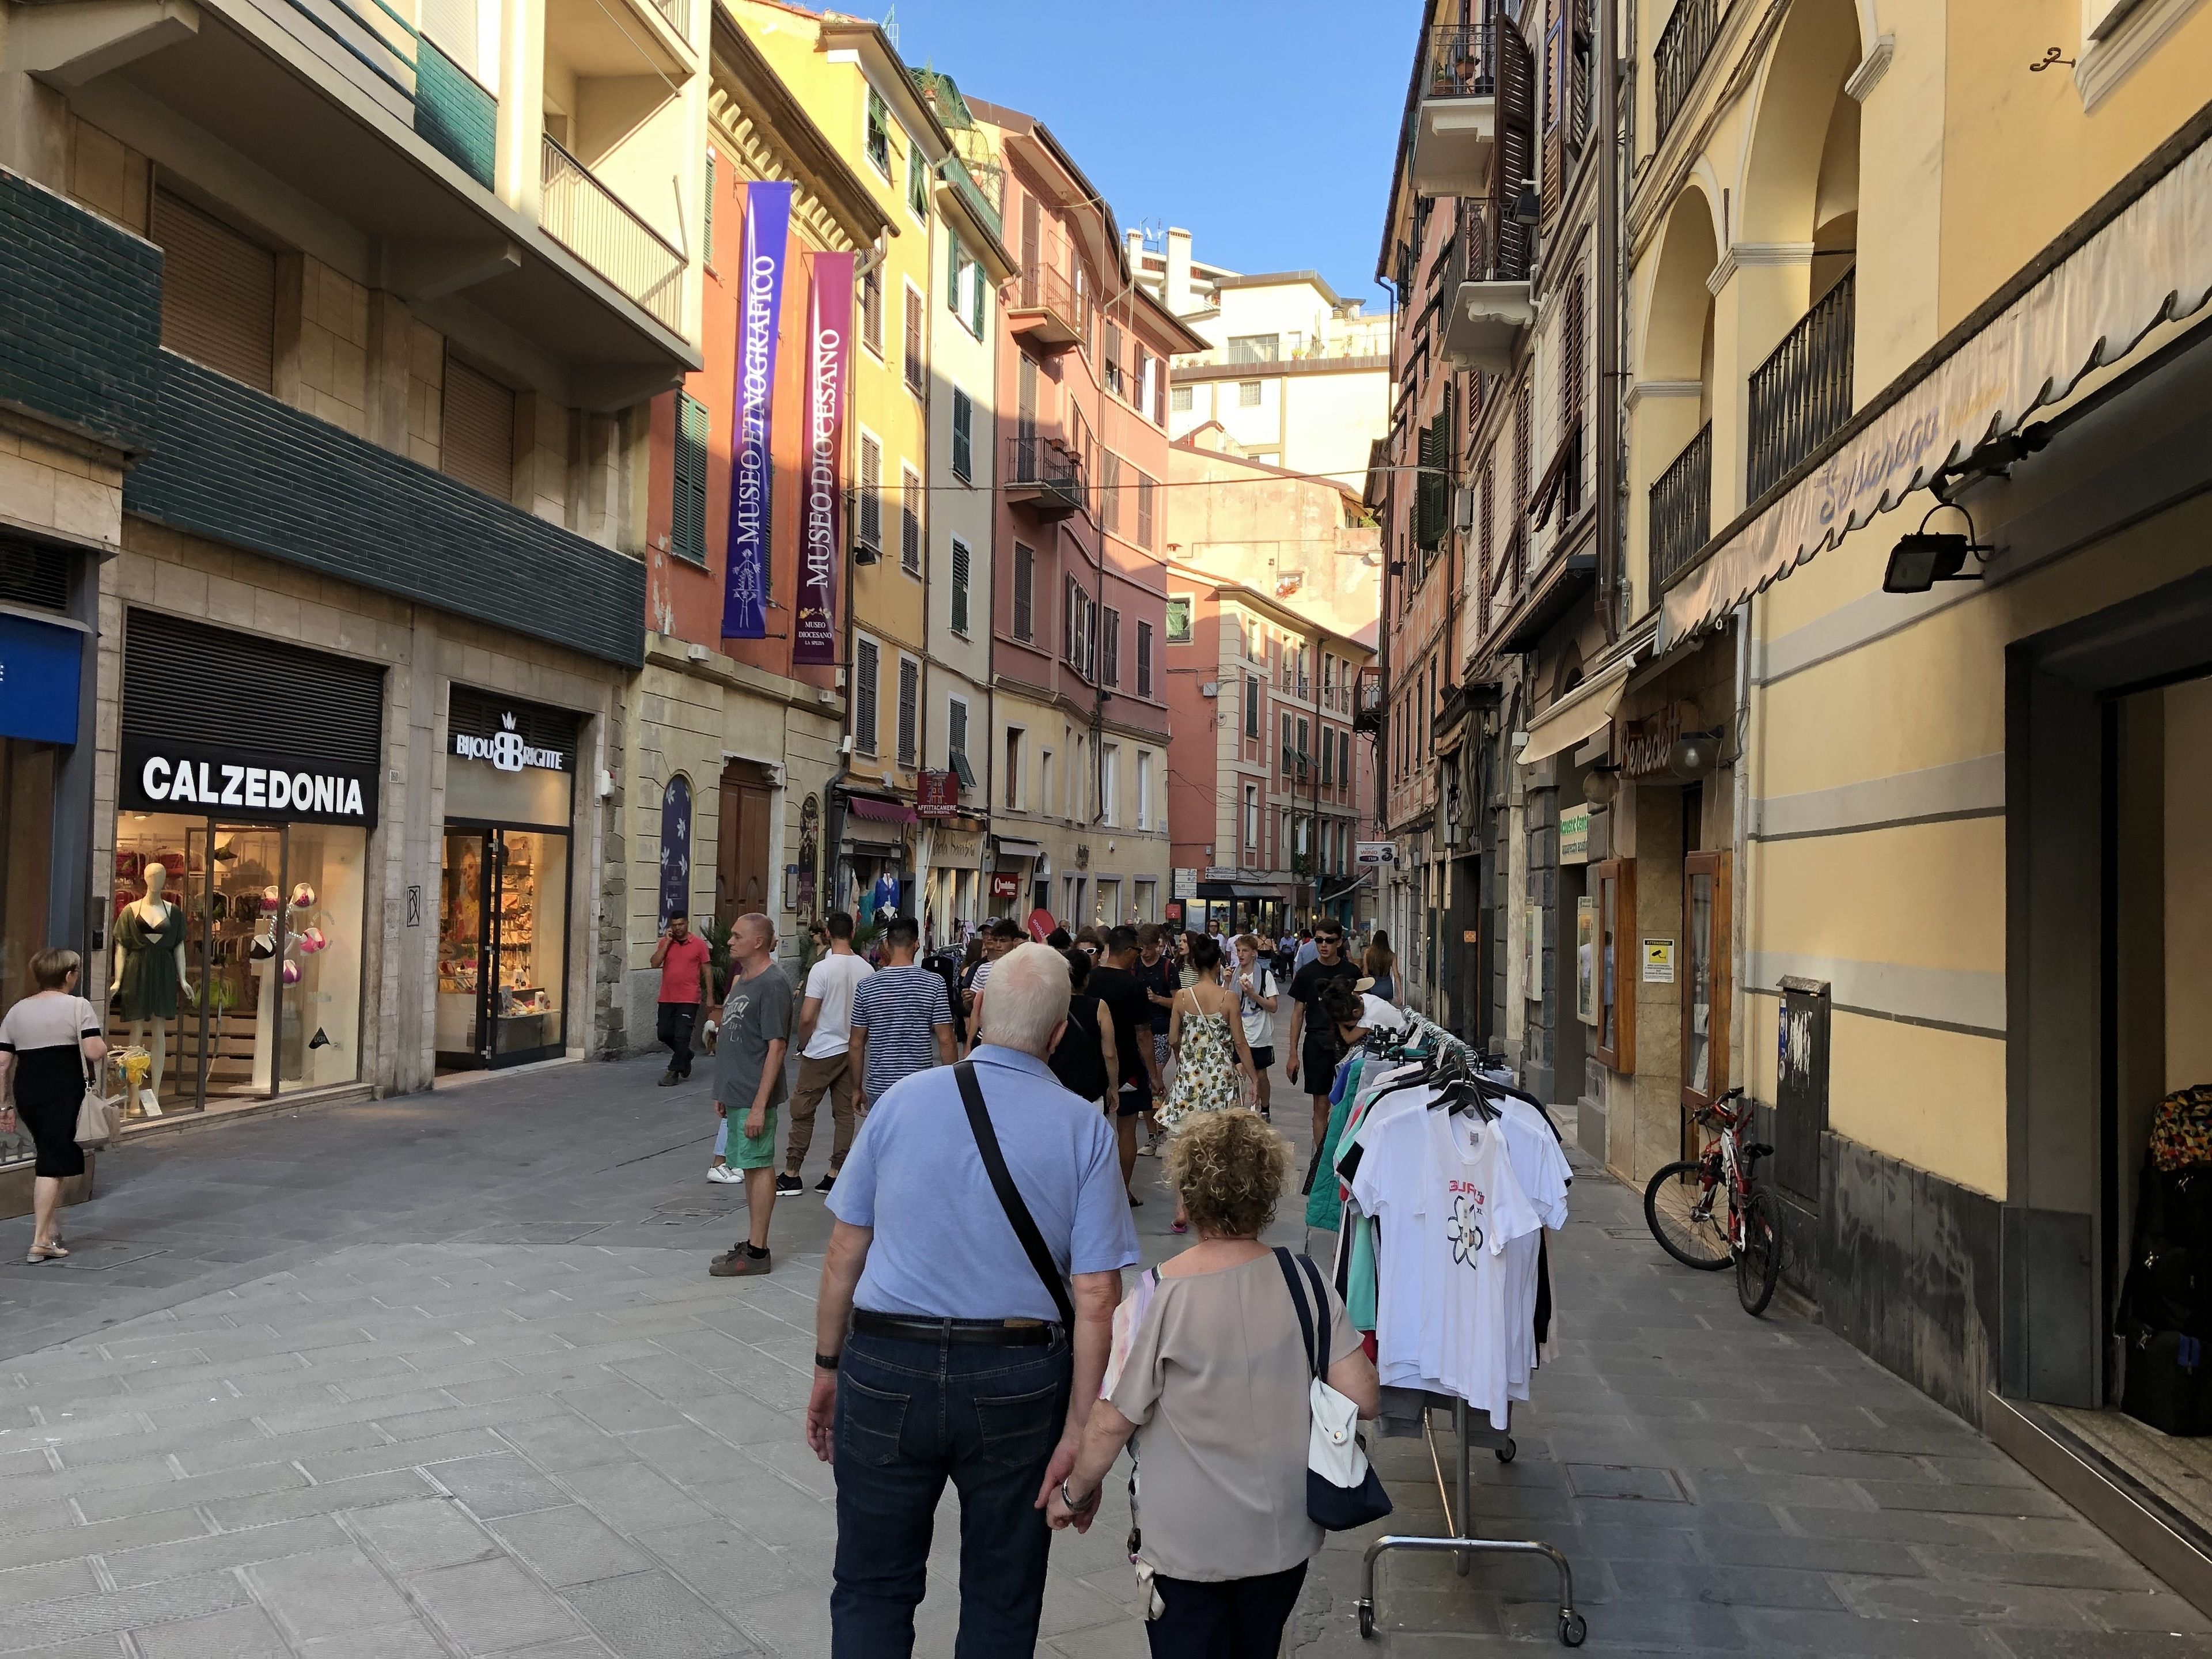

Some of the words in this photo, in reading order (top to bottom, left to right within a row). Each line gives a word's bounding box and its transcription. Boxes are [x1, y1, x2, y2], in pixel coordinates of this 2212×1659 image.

[741, 255, 775, 448] ETNOGRAFICO
[811, 329, 839, 488] DIOCESANO
[737, 450, 762, 545] MUSEO
[806, 491, 832, 588] MUSEO
[143, 756, 364, 815] CALZEDONIA
[457, 734, 494, 760] BIJOU
[1381, 847, 1393, 862] 3
[1476, 1207, 1483, 1215] XL
